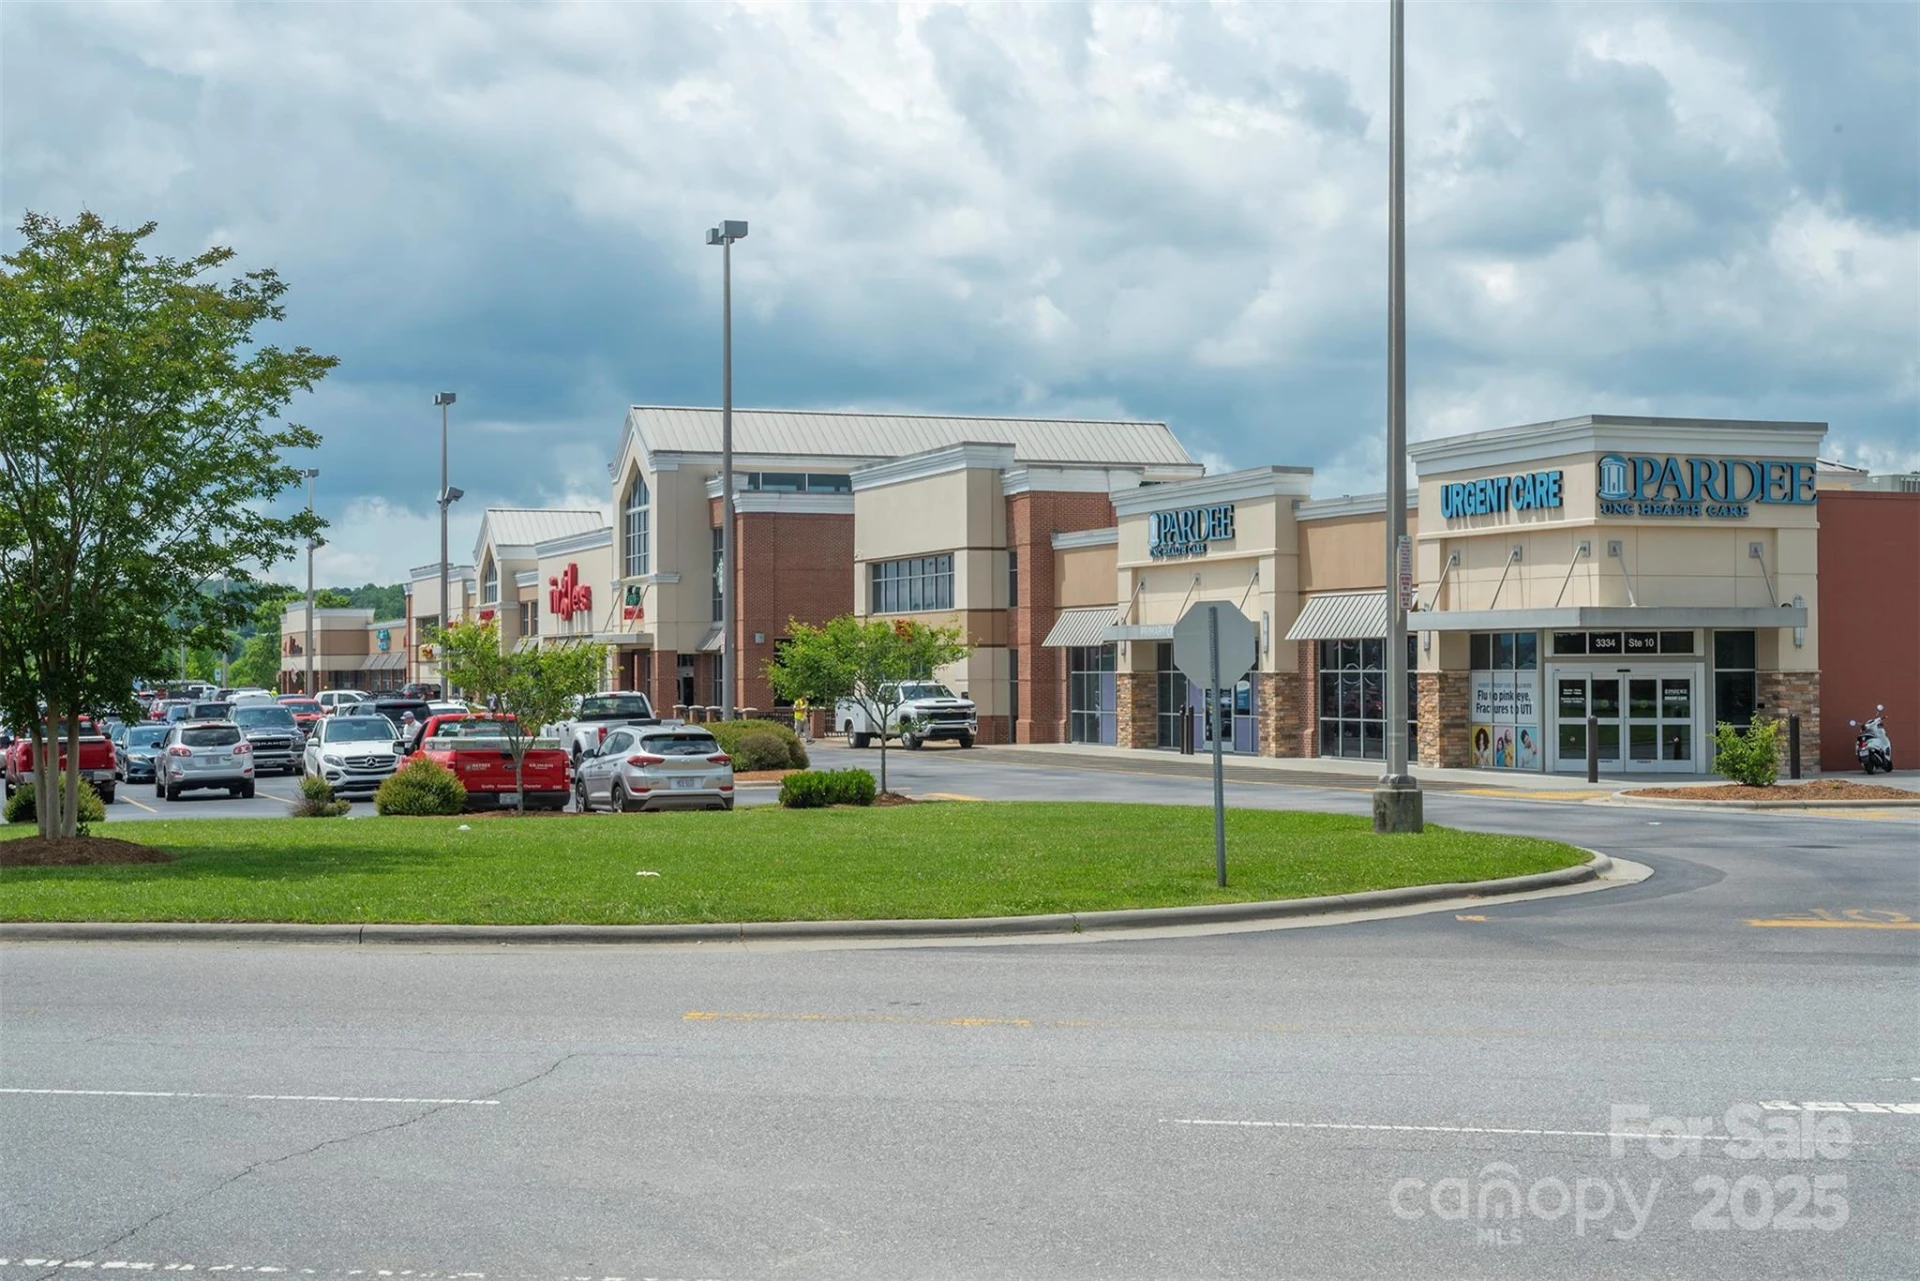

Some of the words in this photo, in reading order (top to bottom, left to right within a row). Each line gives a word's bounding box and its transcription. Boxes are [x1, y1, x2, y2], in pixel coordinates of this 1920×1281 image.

[1628, 456, 1817, 505] PARDEE
[1441, 476, 1511, 519] URGENT
[1511, 471, 1563, 511] CARE
[1600, 502, 1634, 516] UNC
[1638, 502, 1703, 517] HEALTH
[1705, 504, 1750, 519] CARE
[1160, 505, 1235, 545] PARDEE
[548, 562, 592, 621] ingles
[1595, 638, 1616, 648] 3334
[1628, 638, 1642, 648] Ste
[1645, 638, 1654, 648] 10
[1476, 702, 1509, 715] Fracures
[1520, 704, 1532, 715] UTI
[1477, 690, 1488, 701] Flu
[1499, 690, 1514, 702] pink
